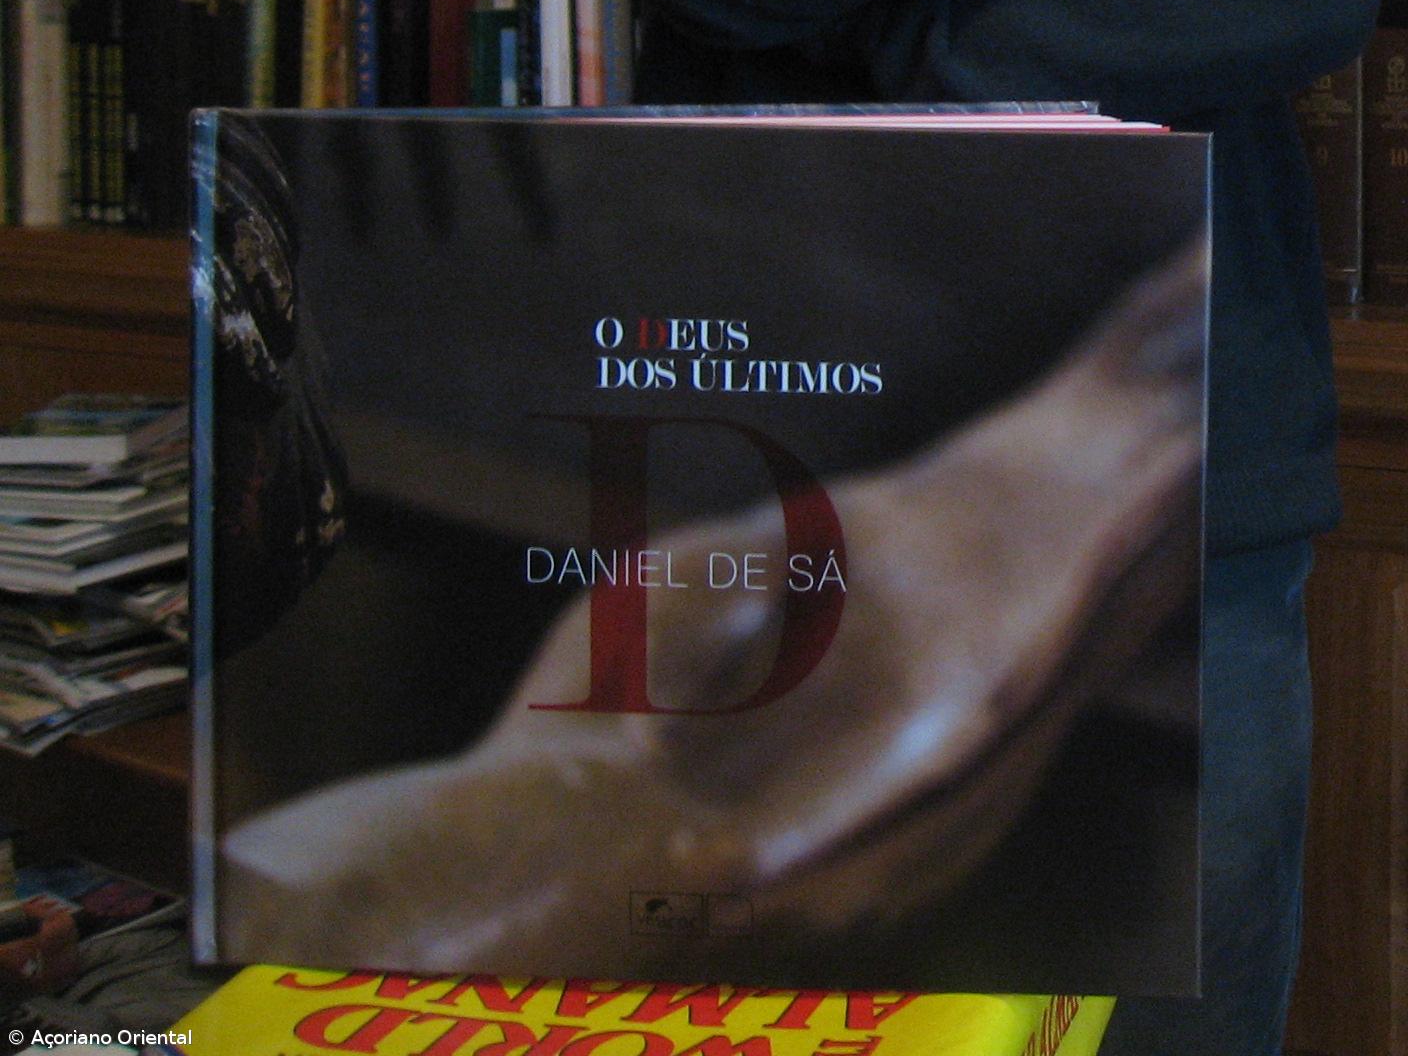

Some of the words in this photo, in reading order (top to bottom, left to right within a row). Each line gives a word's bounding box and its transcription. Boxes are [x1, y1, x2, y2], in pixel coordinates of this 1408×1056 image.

[594, 317, 623, 349] O
[639, 318, 750, 352] DEUS
[598, 356, 677, 389] DOS
[692, 353, 884, 394] ÚLTIMOS
[526, 546, 688, 589] DANIEL
[709, 553, 768, 592] DE
[788, 550, 848, 593] SÁ
